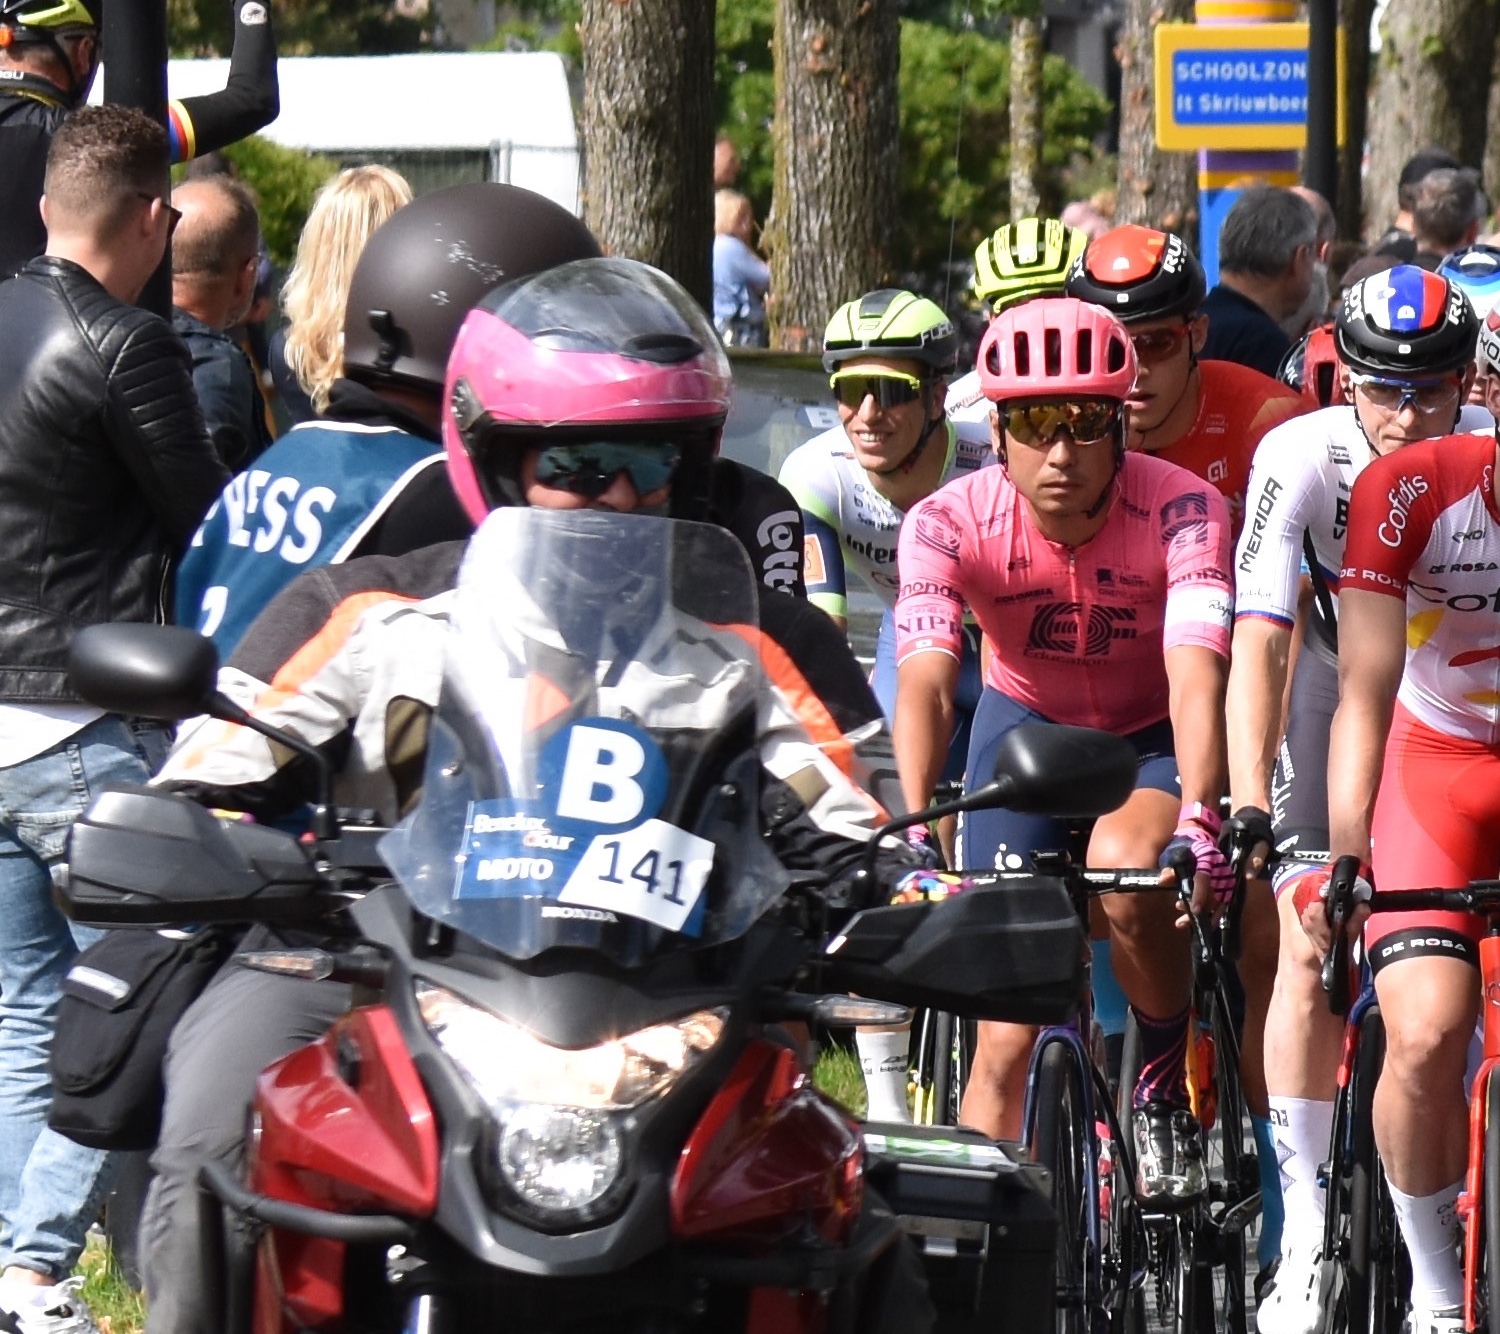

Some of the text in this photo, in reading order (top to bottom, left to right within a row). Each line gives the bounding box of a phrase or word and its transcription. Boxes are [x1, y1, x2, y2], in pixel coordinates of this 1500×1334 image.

[1176, 61, 1308, 81] SCHOOLZON
[1378, 473, 1430, 549] Cofidis
[1239, 476, 1284, 573] MERIDA
[897, 615, 961, 635] NIPP
[556, 725, 647, 825] B
[474, 814, 546, 837] Benelux
[476, 858, 555, 882] MOTO
[599, 841, 687, 906] 141
[1383, 938, 1467, 957] DE ROSA
